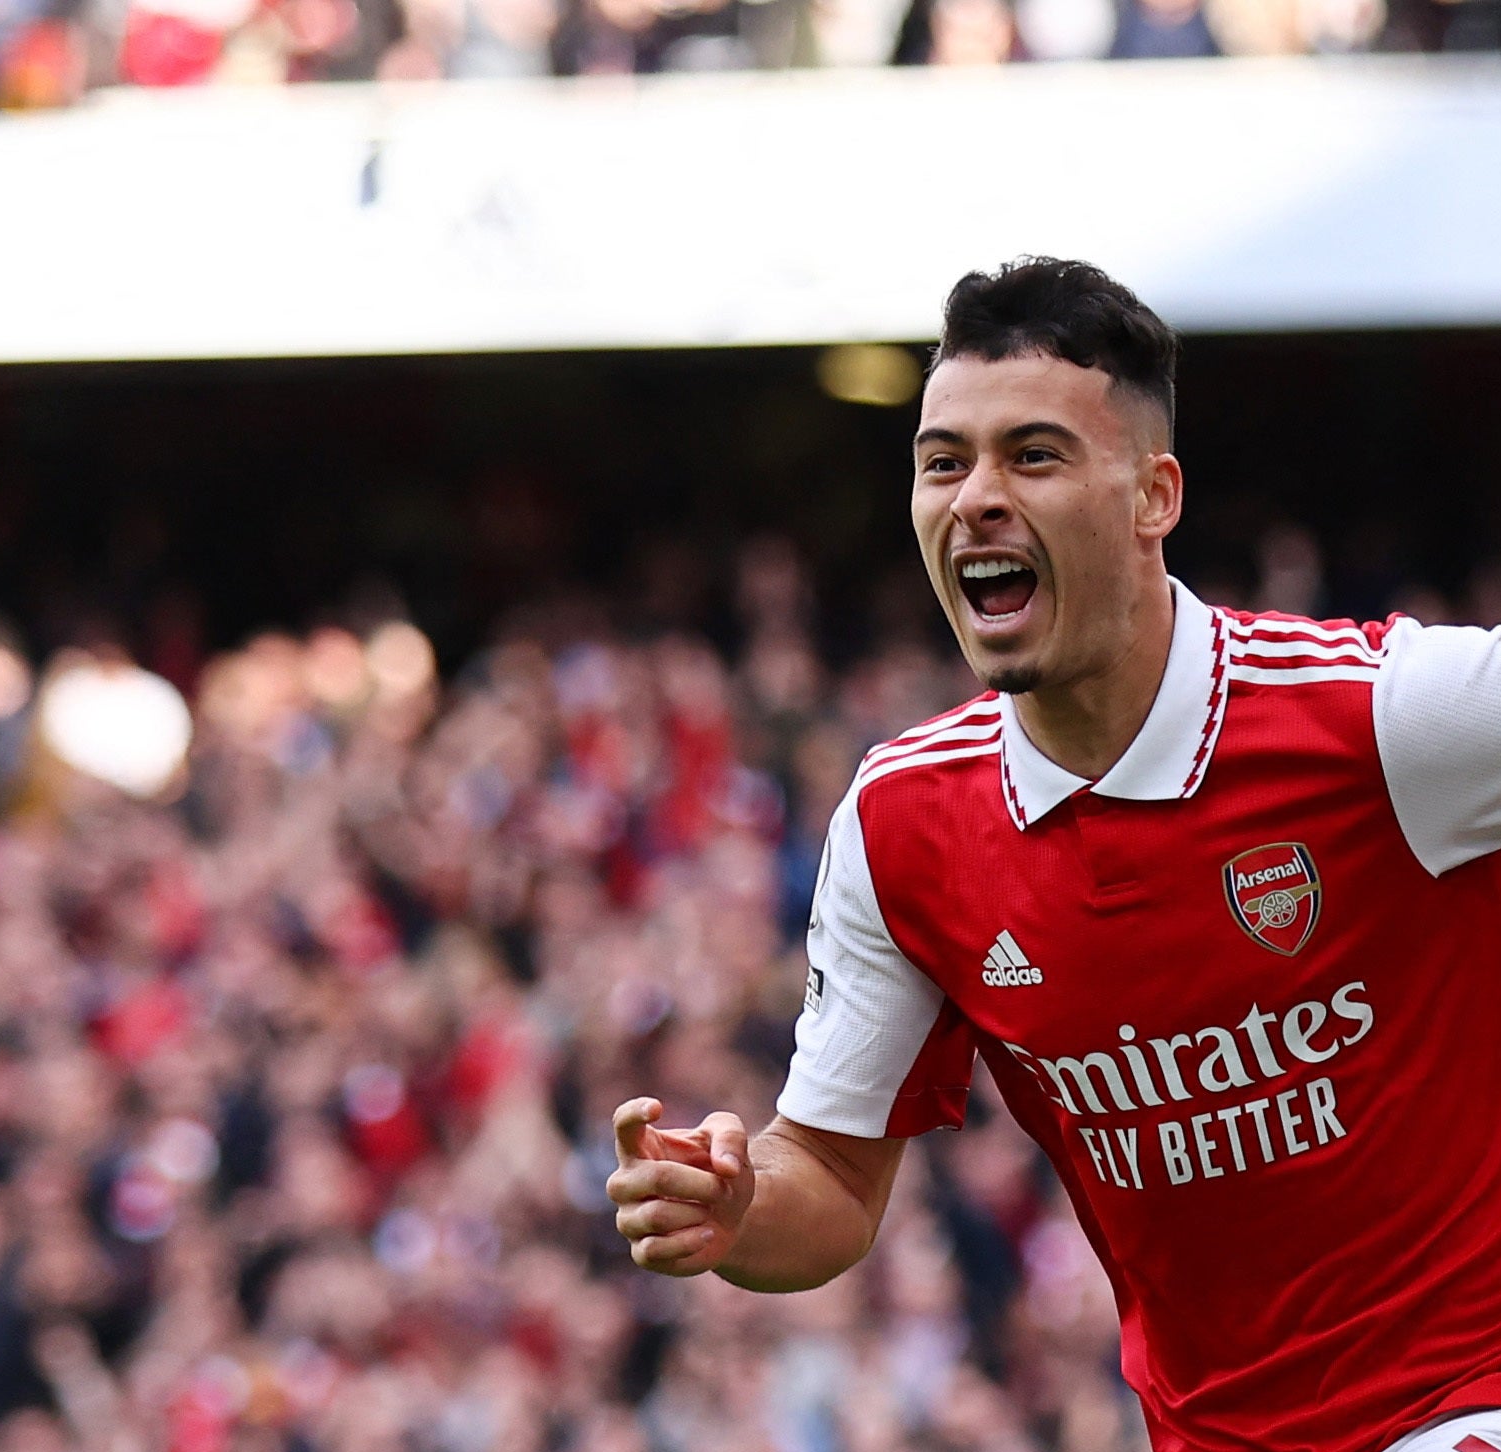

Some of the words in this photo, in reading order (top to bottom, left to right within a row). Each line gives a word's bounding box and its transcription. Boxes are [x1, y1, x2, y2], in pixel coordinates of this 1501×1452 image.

[1236, 857, 1302, 892] Arsenal
[982, 967, 1043, 987] adidas
[1078, 1127, 1144, 1190] FLY
[1157, 1077, 1347, 1186] BETTER
